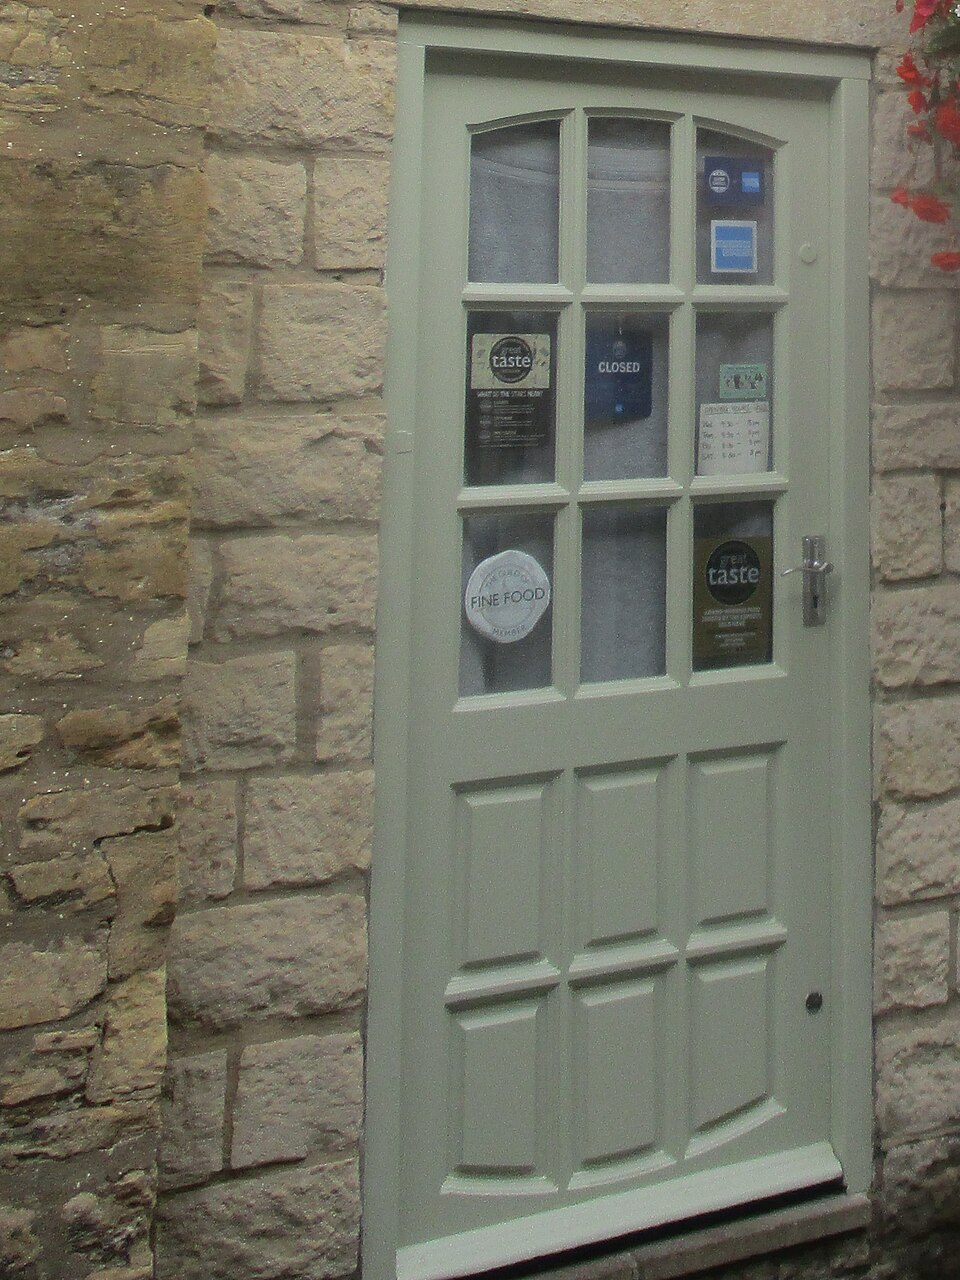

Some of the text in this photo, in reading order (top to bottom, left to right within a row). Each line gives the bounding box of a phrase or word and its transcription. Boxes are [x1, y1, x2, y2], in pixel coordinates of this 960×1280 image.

[491, 355, 531, 368] taste
[598, 361, 640, 373] CLOSED
[708, 565, 759, 585] taste
[470, 587, 546, 609] FINE FOOD
